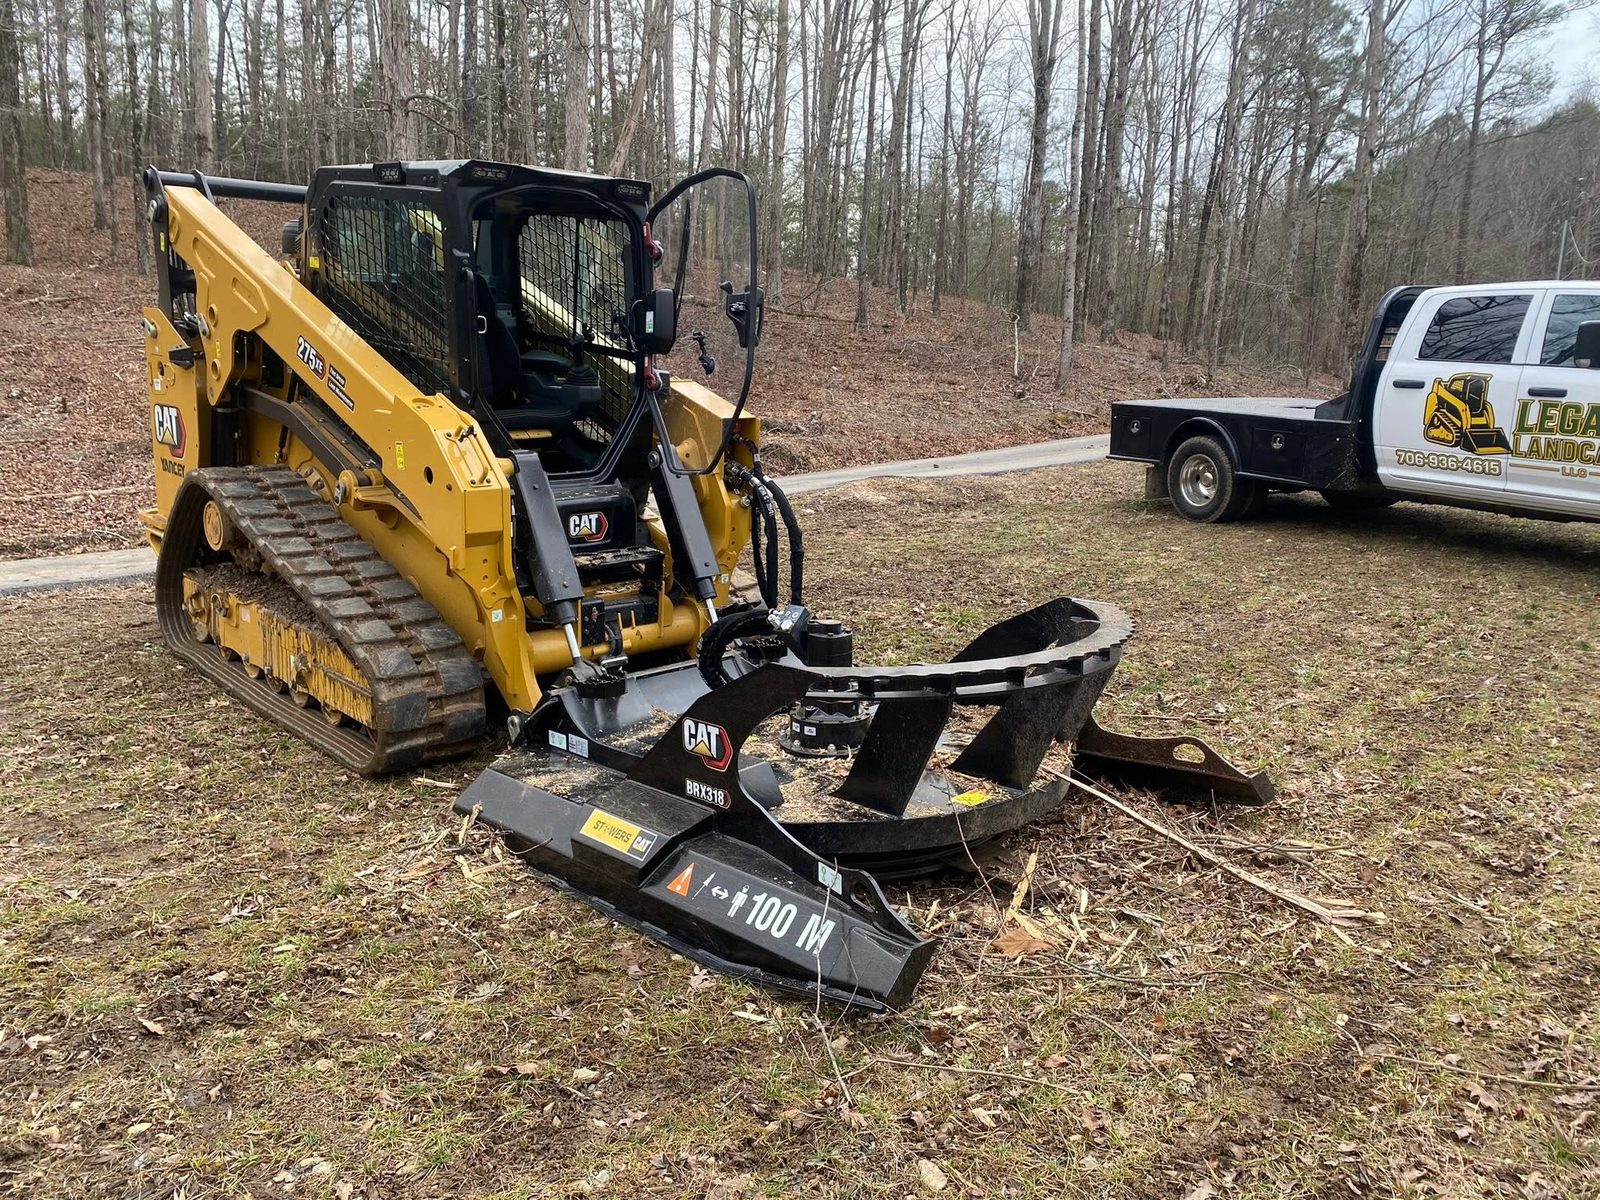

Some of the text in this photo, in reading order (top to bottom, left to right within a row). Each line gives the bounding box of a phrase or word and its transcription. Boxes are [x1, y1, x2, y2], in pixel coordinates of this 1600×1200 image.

[154, 404, 178, 446] CAT
[160, 457, 186, 478] YANCEY
[1396, 449, 1501, 476] 706-936-4615
[1561, 466, 1588, 478] LLC
[570, 513, 599, 536] CAT
[683, 719, 720, 759] CAT
[686, 779, 725, 806] BRX318
[632, 836, 652, 853] CAT
[745, 892, 836, 956] 100 M
